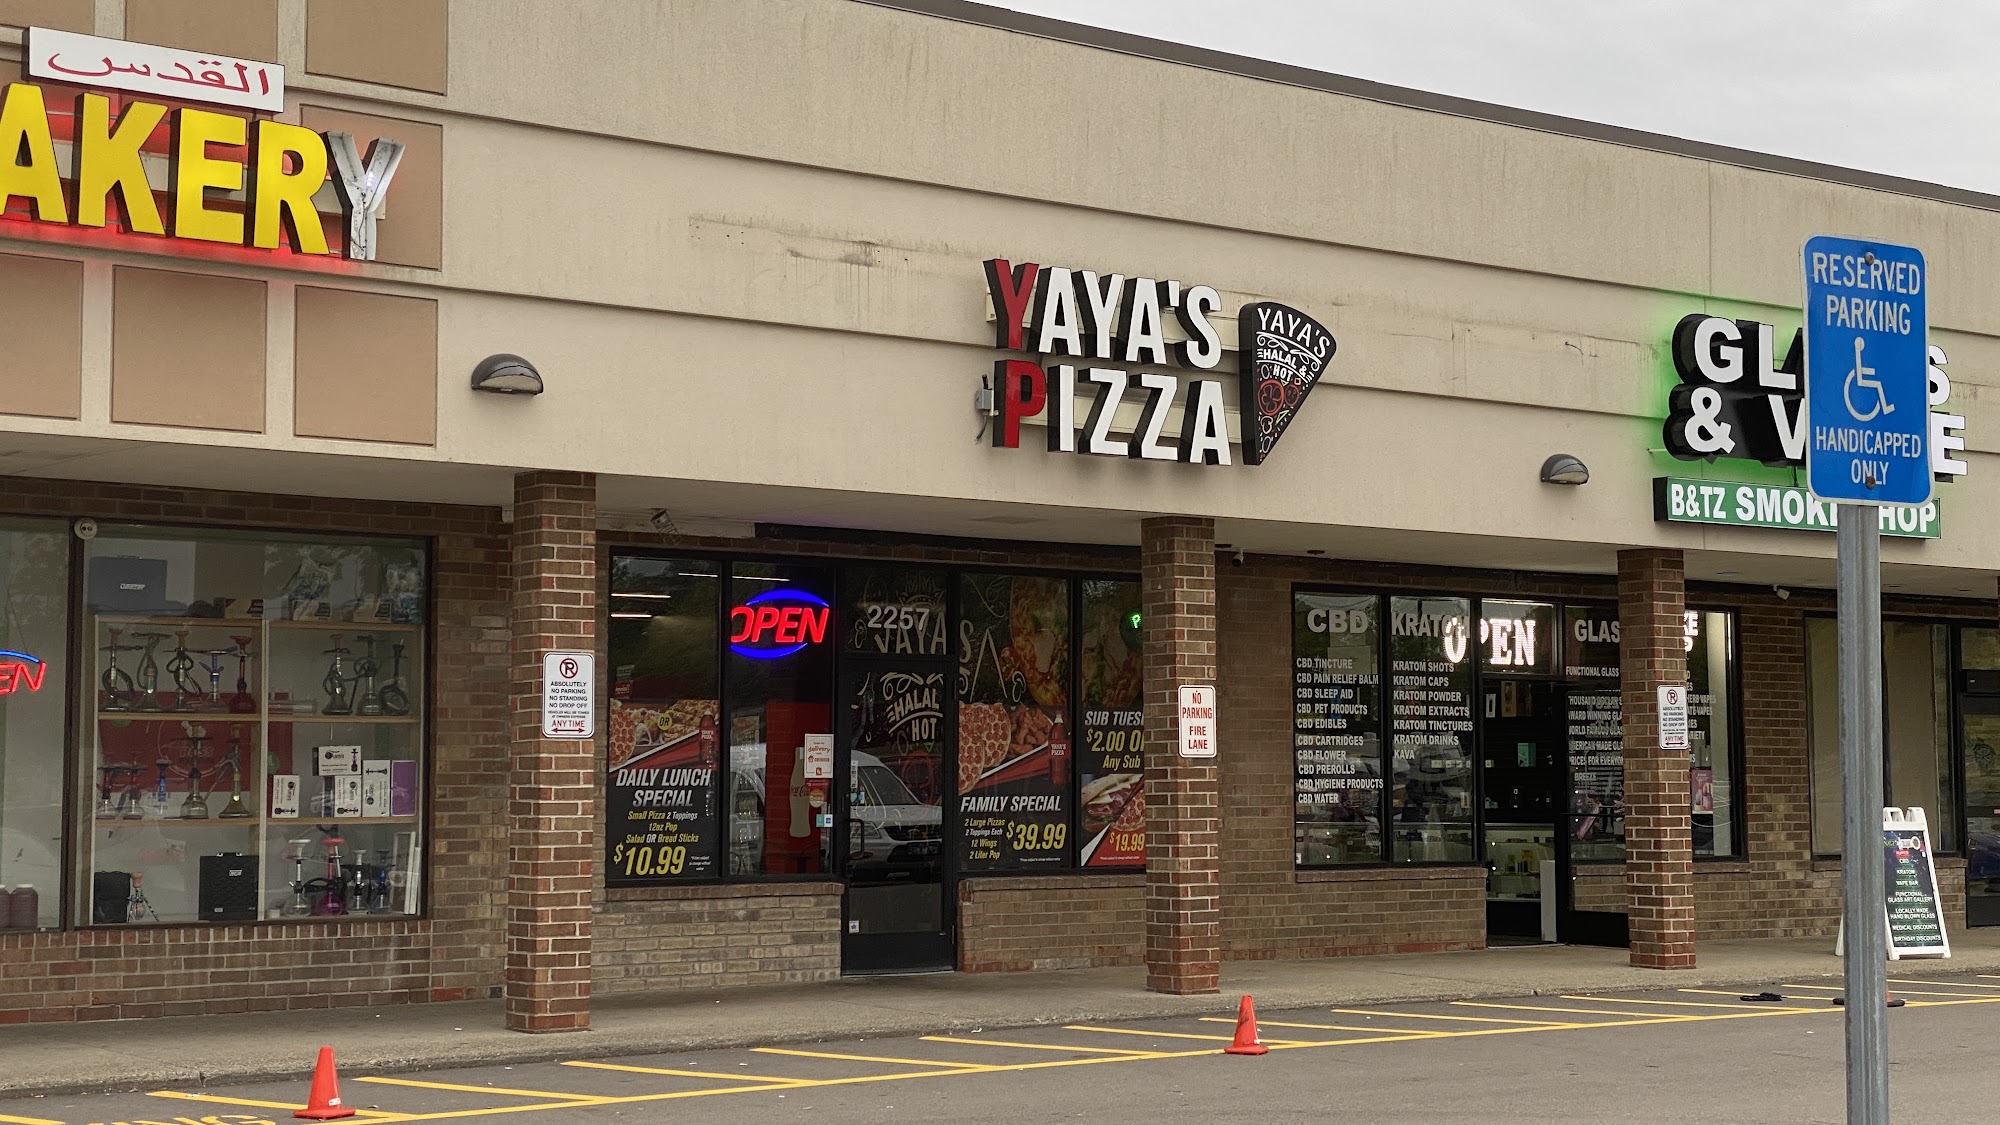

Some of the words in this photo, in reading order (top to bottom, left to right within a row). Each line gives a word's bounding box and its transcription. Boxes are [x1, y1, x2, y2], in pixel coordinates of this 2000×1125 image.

[48, 53, 271, 96] القدس
[1813, 252, 1921, 294] RESERVED
[987, 258, 1222, 369] YAYA'S
[1826, 295, 1911, 335] PARKING
[1257, 307, 1331, 359] YAYA'S
[1264, 348, 1297, 369] HALAL
[1692, 317, 1951, 406] GLS
[1274, 364, 1293, 382] HOT
[996, 360, 1233, 466] PIZZA
[1684, 386, 1736, 454] &
[1767, 394, 1968, 475] VE
[1816, 426, 1921, 458] HANDICAPPED
[1851, 461, 1889, 486] ONLY
[1671, 483, 1727, 519] B&TZ
[1879, 500, 1937, 533] HOP
[867, 604, 930, 630] 2257
[1307, 608, 1369, 634] CBD
[730, 606, 830, 643] OPEN
[1391, 611, 1471, 639] KRATOM
[1296, 658, 1312, 668] CBD
[1314, 659, 1353, 669] TINCTURE
[1393, 661, 1426, 672] KRATOM
[1428, 662, 1454, 673] SHOTS
[1566, 666, 1599, 677] FUNCTIONAL
[1601, 667, 1619, 678] GLASS
[1296, 674, 1312, 684] CBD
[1313, 674, 1330, 684] PAIN
[1332, 674, 1357, 684] RELIEF
[1359, 675, 1379, 685] BALM
[1393, 676, 1426, 687] KRATOM
[1428, 677, 1449, 687] CAPS
[1192, 692, 1202, 704] NO
[1297, 689, 1312, 698] CBD
[1314, 689, 1339, 699] SLEEP
[1340, 690, 1353, 699] AID
[1393, 691, 1426, 701] KRATOM
[1428, 692, 1461, 702] POWDER
[893, 687, 940, 722] HALAL
[1297, 703, 1311, 713] CBD
[1314, 704, 1328, 713] PET
[1331, 704, 1368, 715] PRODUCTS
[1182, 707, 1212, 718] PARKING
[1394, 705, 1426, 716] KRATOM
[1428, 705, 1470, 717] EXTRACTS
[659, 716, 670, 727] OR
[1085, 711, 1109, 726] SUB
[1297, 719, 1312, 728] CBD
[1315, 719, 1347, 729] EDIBLES
[912, 717, 937, 742] HOT
[1189, 726, 1206, 736] FIRE
[1394, 720, 1427, 730] KRATOM
[1429, 721, 1473, 731] TINCTURES
[1087, 728, 1125, 752] $2.00
[1188, 739, 1208, 749] LANE
[1297, 736, 1313, 745] CBD
[1315, 736, 1364, 746] CARTRIDGES
[1394, 734, 1427, 745] KRATOM
[1429, 735, 1459, 746] DRINKS
[1297, 750, 1313, 759] CBD
[1315, 750, 1346, 760] FLOWER
[1394, 749, 1415, 760] KAVA
[1103, 755, 1121, 771] Any
[1123, 754, 1140, 768] Sub
[1298, 764, 1314, 774] CBD
[1316, 764, 1355, 775] PREROLLS
[616, 769, 660, 787] DAILY
[661, 769, 711, 787] LUNCH
[1298, 779, 1313, 788] CBD
[1315, 779, 1345, 790] HYGIENE
[1347, 779, 1384, 789] PRODUCTS
[633, 790, 693, 807] SPECIAL
[960, 796, 1009, 812] FAMILY
[1010, 795, 1061, 812] SPECIAL
[1298, 793, 1313, 803] CBD
[1314, 793, 1339, 803] WATER
[628, 810, 647, 819] Small
[648, 810, 665, 819] Pizza
[666, 811, 672, 819] 2
[672, 811, 698, 821] Toppings
[649, 823, 664, 831] 12oz
[665, 822, 678, 832] Pop
[970, 818, 986, 828] Large
[987, 818, 1005, 826] Pizzas
[626, 834, 645, 843] Salad
[646, 834, 656, 843] OR
[657, 834, 678, 843] Bread
[678, 833, 699, 843] Sticks
[970, 828, 991, 837] Toppings
[991, 828, 1003, 836] Each
[1006, 820, 1067, 850] $39.99
[971, 839, 978, 847] 12
[979, 838, 997, 849] Wings
[1110, 833, 1145, 852] $19.99
[614, 843, 686, 876] $10.99
[969, 851, 974, 859] 2
[974, 850, 988, 859] Liter
[988, 850, 1000, 860] Pop
